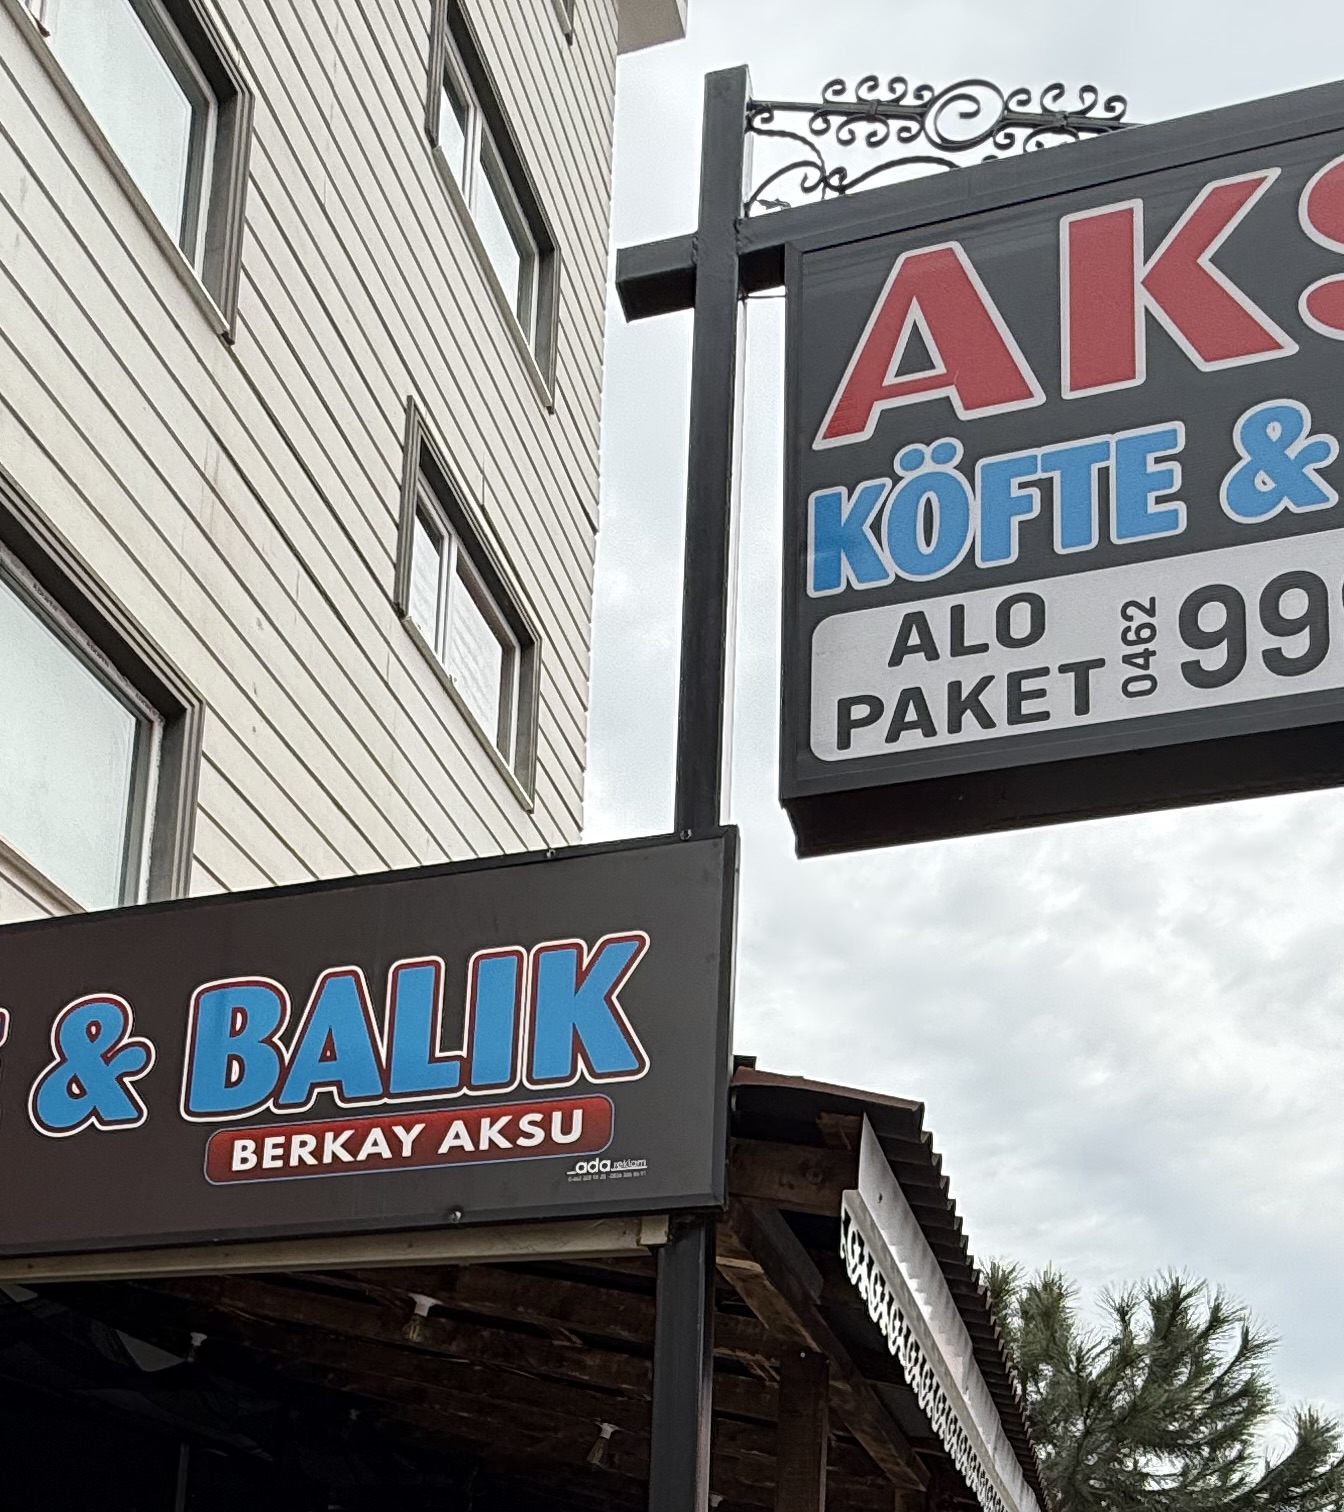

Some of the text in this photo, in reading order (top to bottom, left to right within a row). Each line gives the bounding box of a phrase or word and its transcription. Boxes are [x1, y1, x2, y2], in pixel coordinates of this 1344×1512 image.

[807, 422, 1189, 598] KÖFTE
[1219, 398, 1339, 524] &
[889, 591, 1047, 670] ALO
[1120, 596, 1160, 697] 0462
[835, 657, 1106, 751] PAKET
[28, 991, 154, 1138] &
[180, 931, 650, 1122] BALIK
[232, 1109, 583, 1171] BERKAY AKSU
